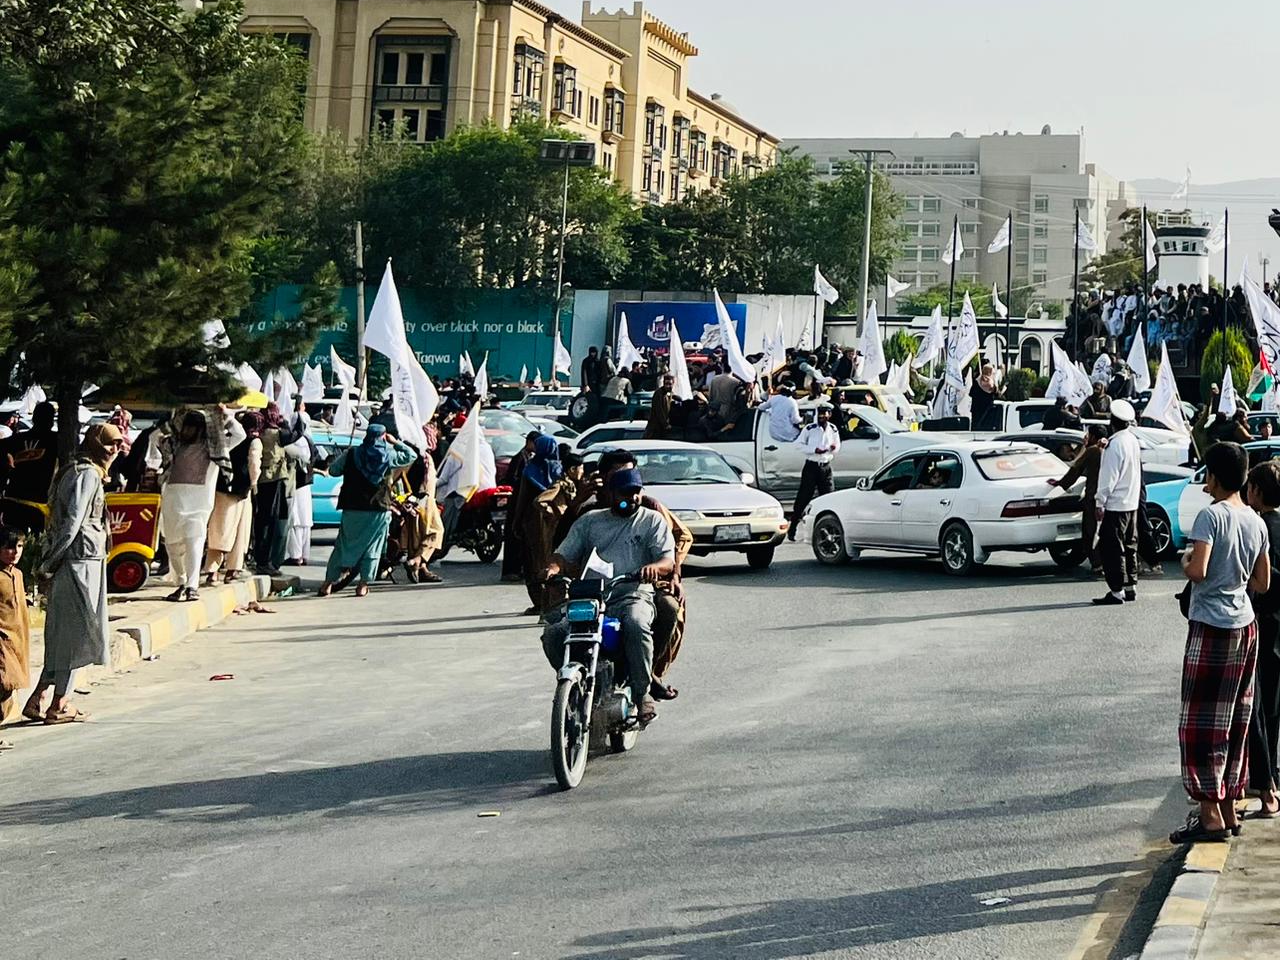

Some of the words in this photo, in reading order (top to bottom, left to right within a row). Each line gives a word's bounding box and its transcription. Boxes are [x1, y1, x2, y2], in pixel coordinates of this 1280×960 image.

[421, 321, 447, 333] over
[450, 319, 479, 333] black
[483, 322, 504, 334] nor
[505, 322, 514, 333] a
[517, 319, 545, 334] black
[415, 350, 455, 366] Taqwa.
